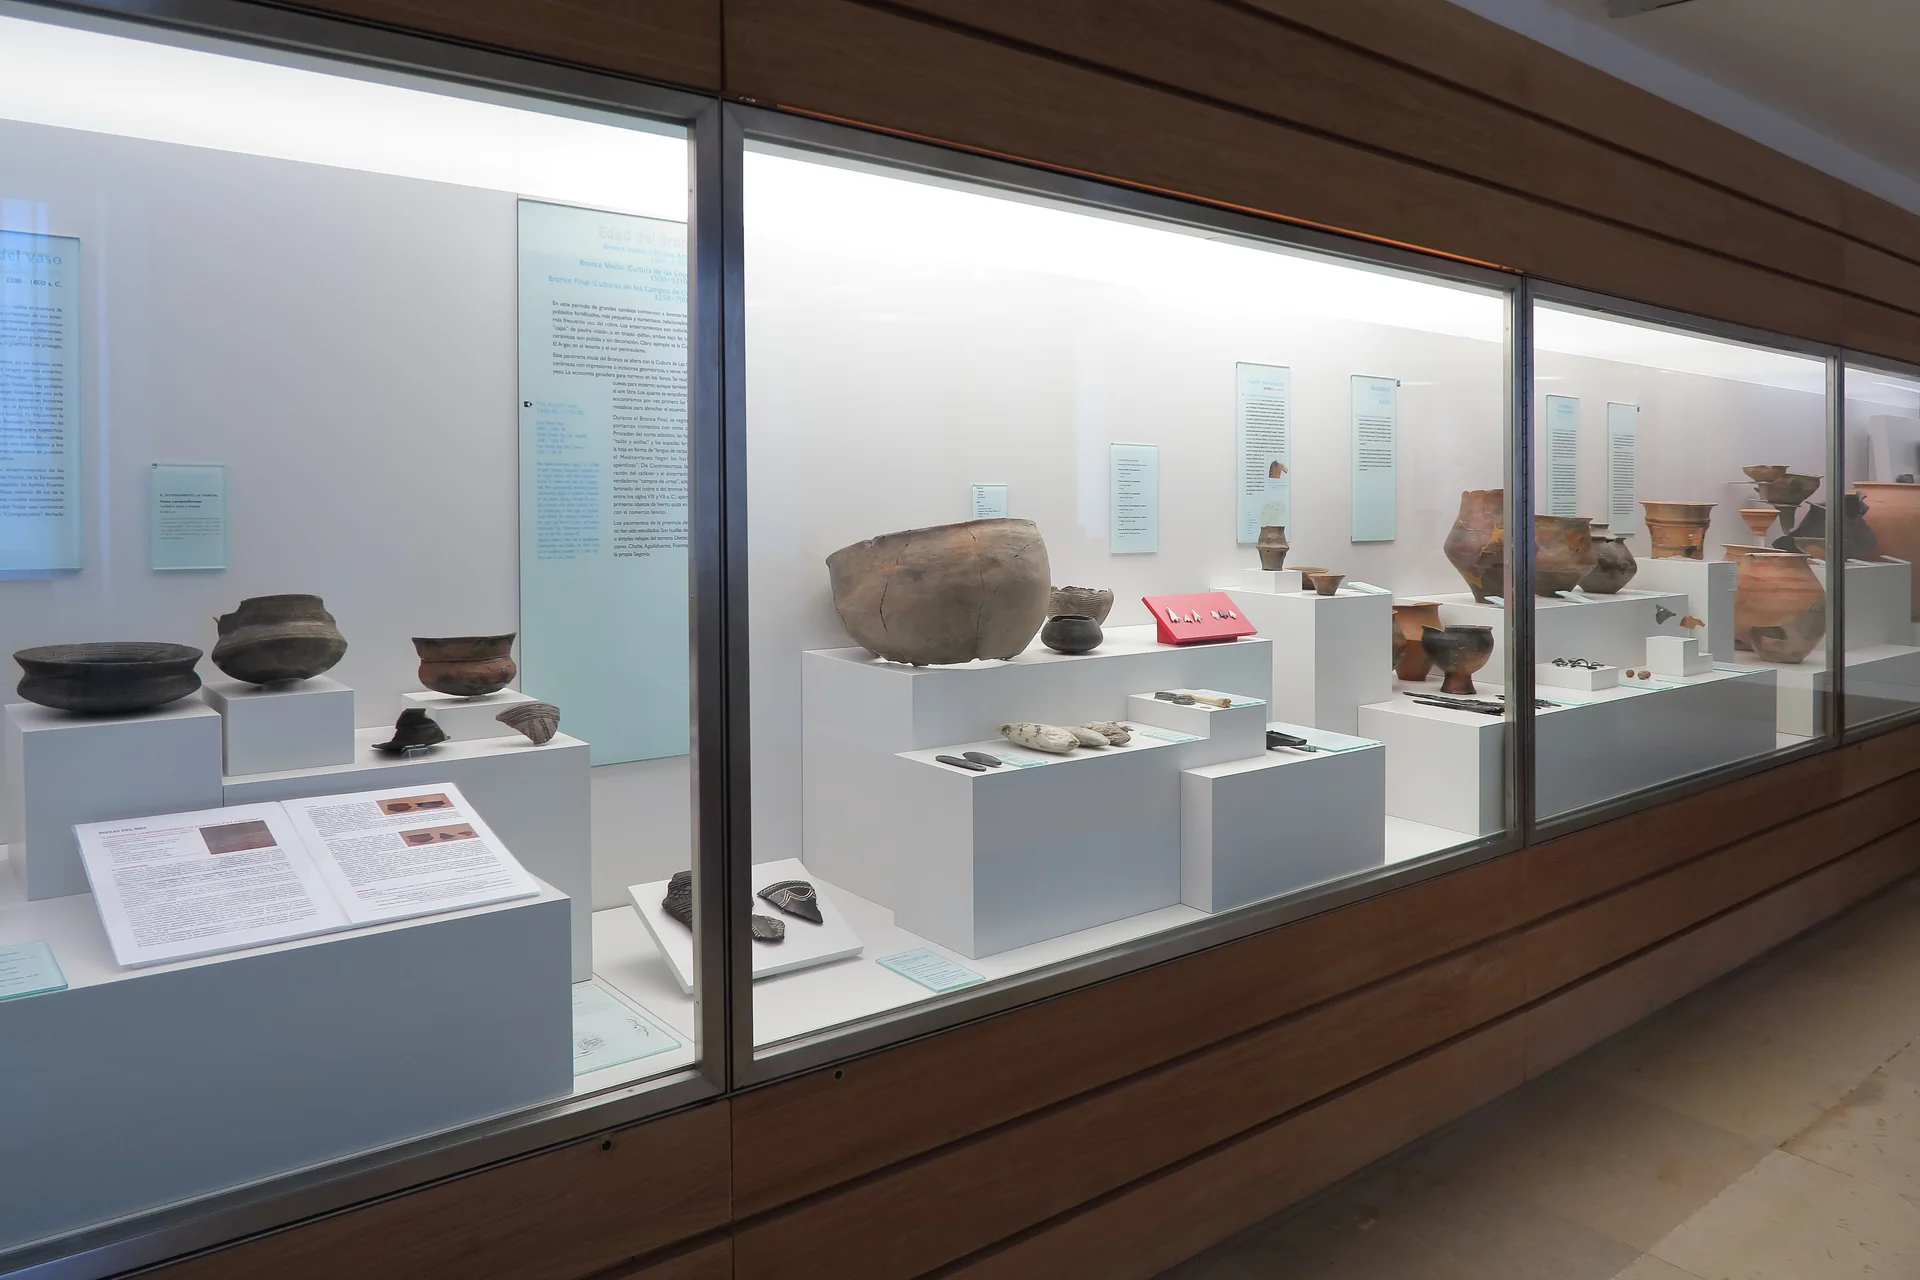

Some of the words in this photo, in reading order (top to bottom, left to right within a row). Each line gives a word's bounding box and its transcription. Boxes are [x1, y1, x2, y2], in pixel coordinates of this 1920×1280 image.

[598, 226, 630, 242] Edad
[636, 231, 656, 244] del
[26, 251, 62, 265] Vaso
[580, 260, 602, 268] Bronce
[604, 262, 625, 271] Medio
[548, 275, 572, 284] Bronce
[644, 286, 670, 296] Campos
[611, 314, 632, 322] pequeños
